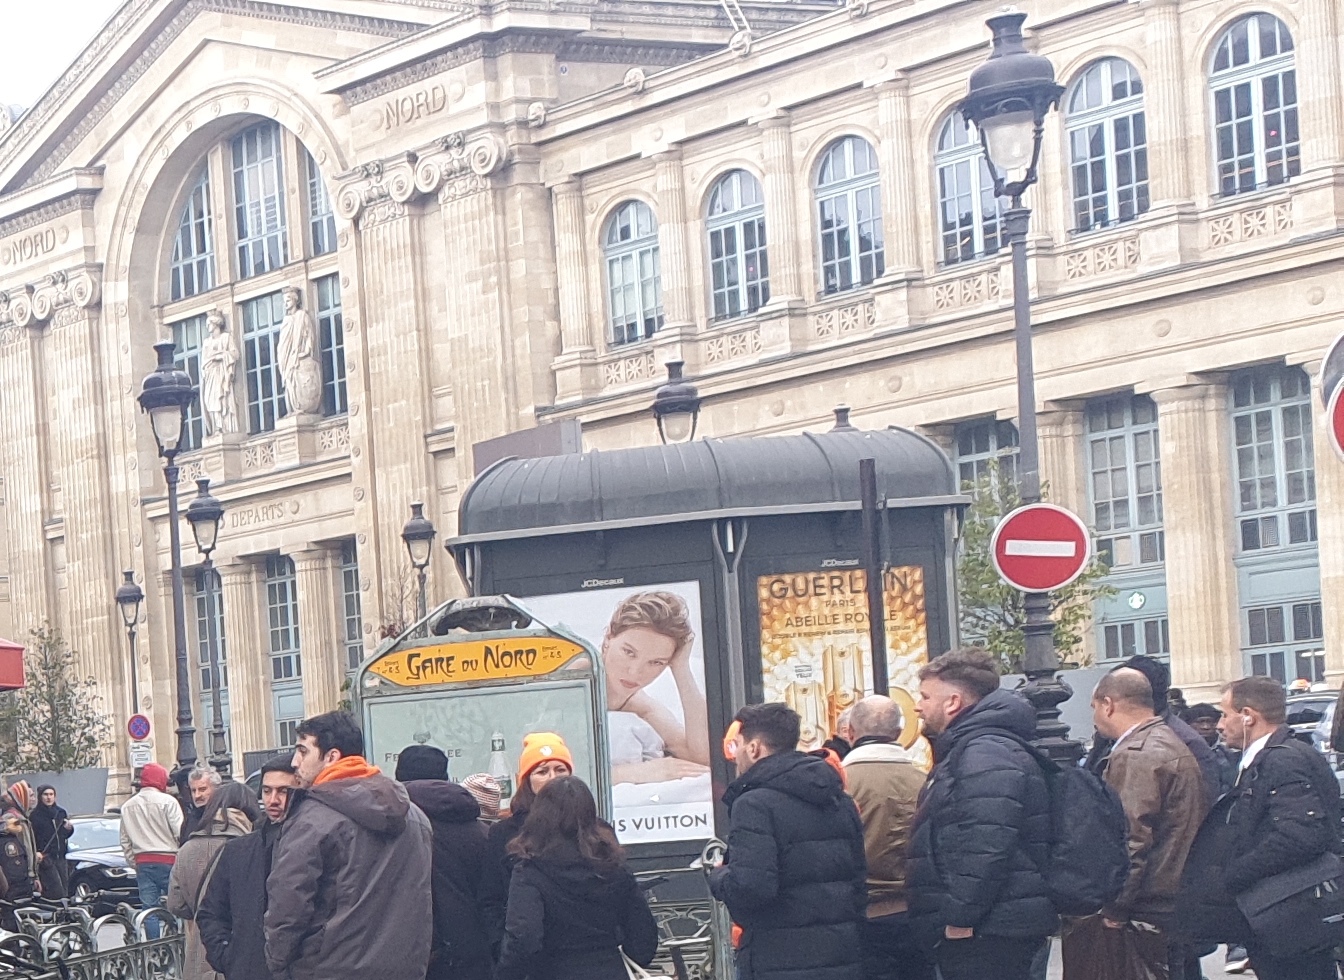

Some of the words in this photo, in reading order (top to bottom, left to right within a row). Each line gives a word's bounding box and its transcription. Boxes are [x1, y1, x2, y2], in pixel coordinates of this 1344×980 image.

[385, 84, 447, 130] NORD
[12, 227, 56, 265] NORD
[231, 502, 284, 528] DEPARTS
[769, 571, 909, 599] GUERLIN
[785, 613, 841, 628] ABEILLE
[631, 813, 707, 830] VUITTON
